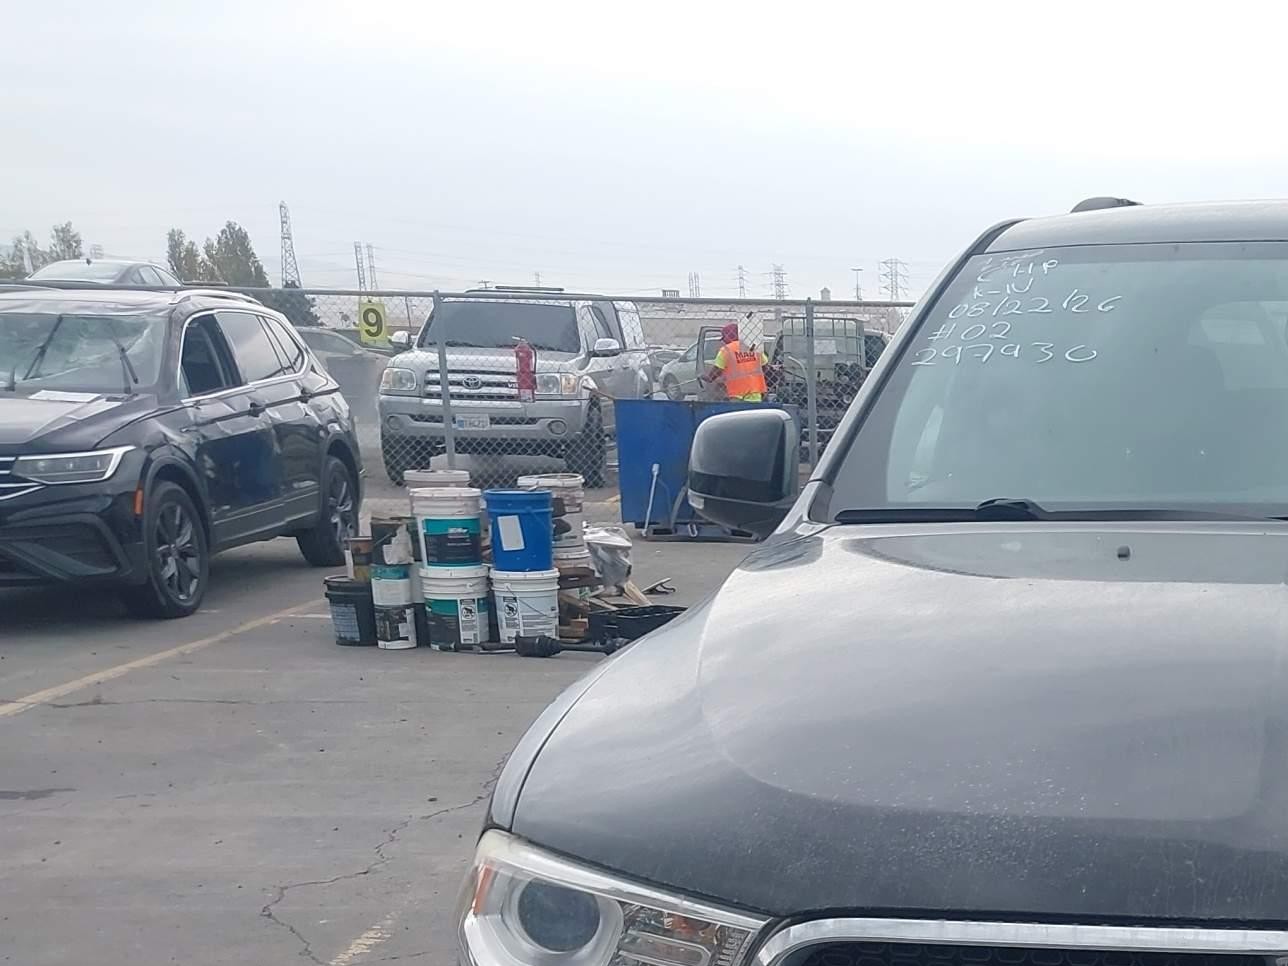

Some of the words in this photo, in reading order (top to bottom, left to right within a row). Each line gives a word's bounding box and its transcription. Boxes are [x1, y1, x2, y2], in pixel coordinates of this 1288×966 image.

[948, 289, 1123, 319] 08/22/26
[362, 307, 384, 338] 9
[927, 321, 1012, 342] #02
